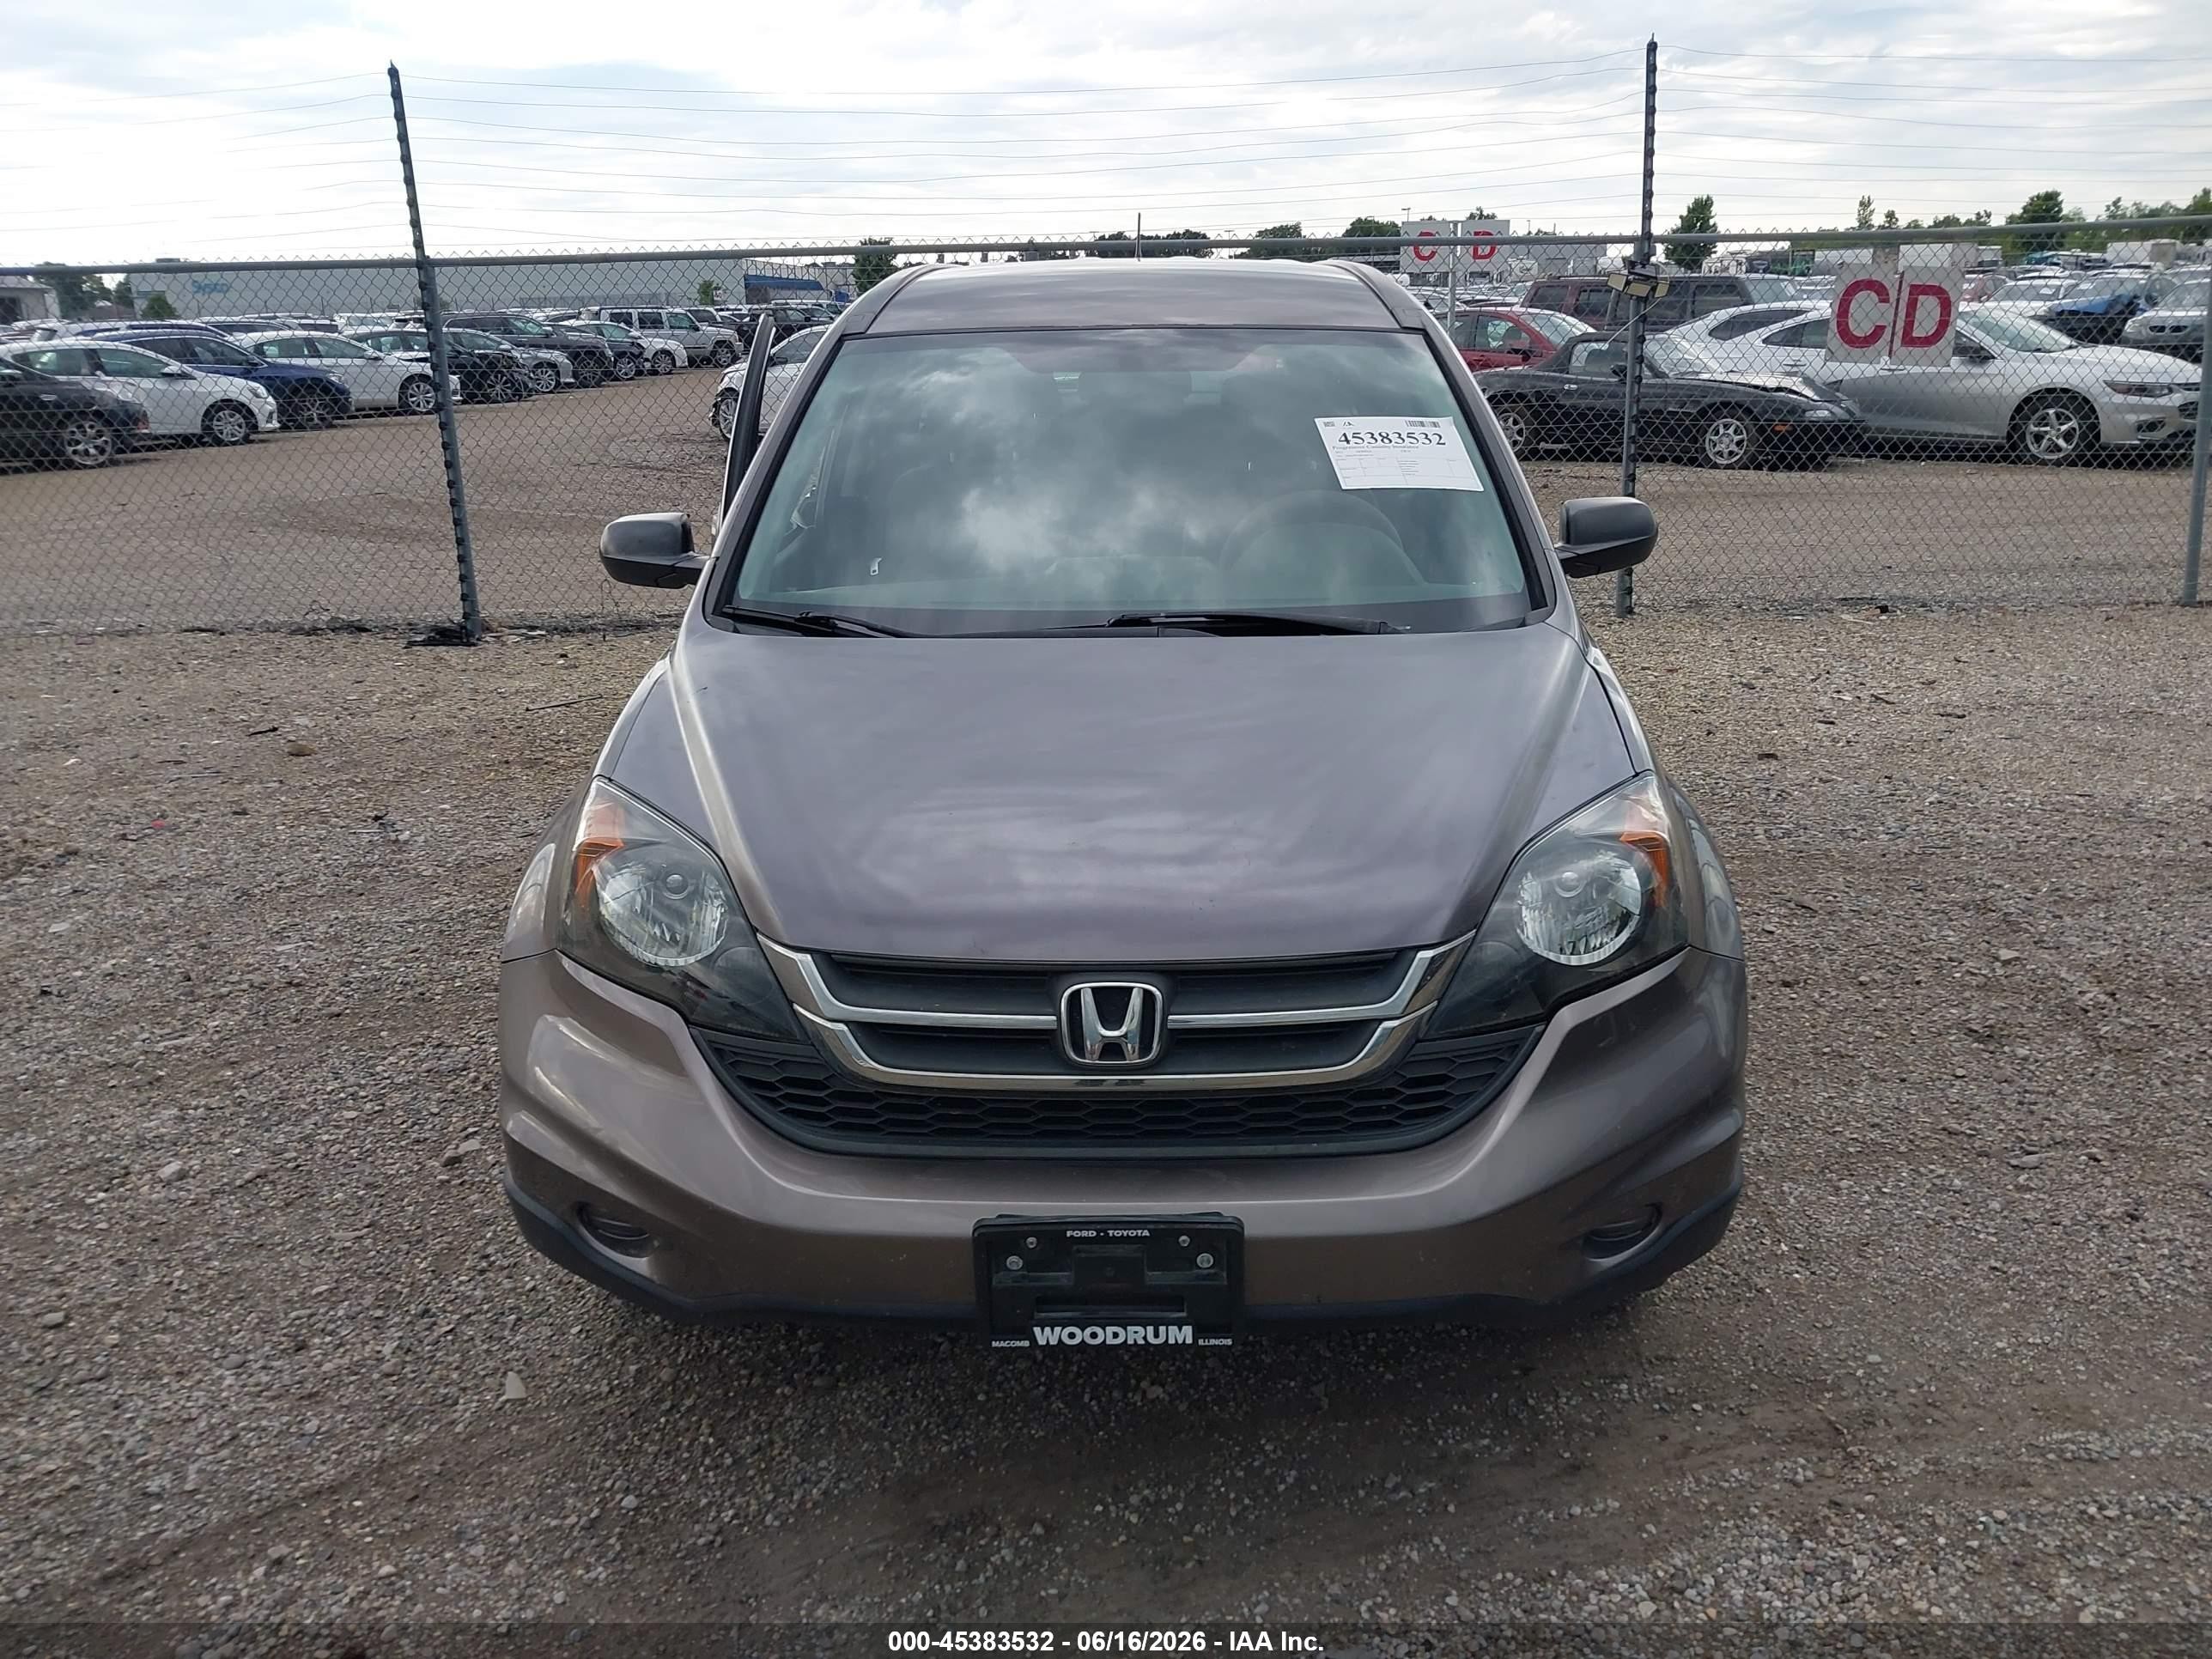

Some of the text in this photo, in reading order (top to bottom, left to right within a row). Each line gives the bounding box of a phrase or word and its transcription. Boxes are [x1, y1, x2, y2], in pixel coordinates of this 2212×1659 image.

[1413, 231, 1497, 261] C D
[1836, 279, 1952, 349] C D
[1338, 431, 1446, 446] 45383532
[1107, 1229, 1151, 1237] TOYOTA
[1032, 1325, 1194, 1346] WOODRUM
